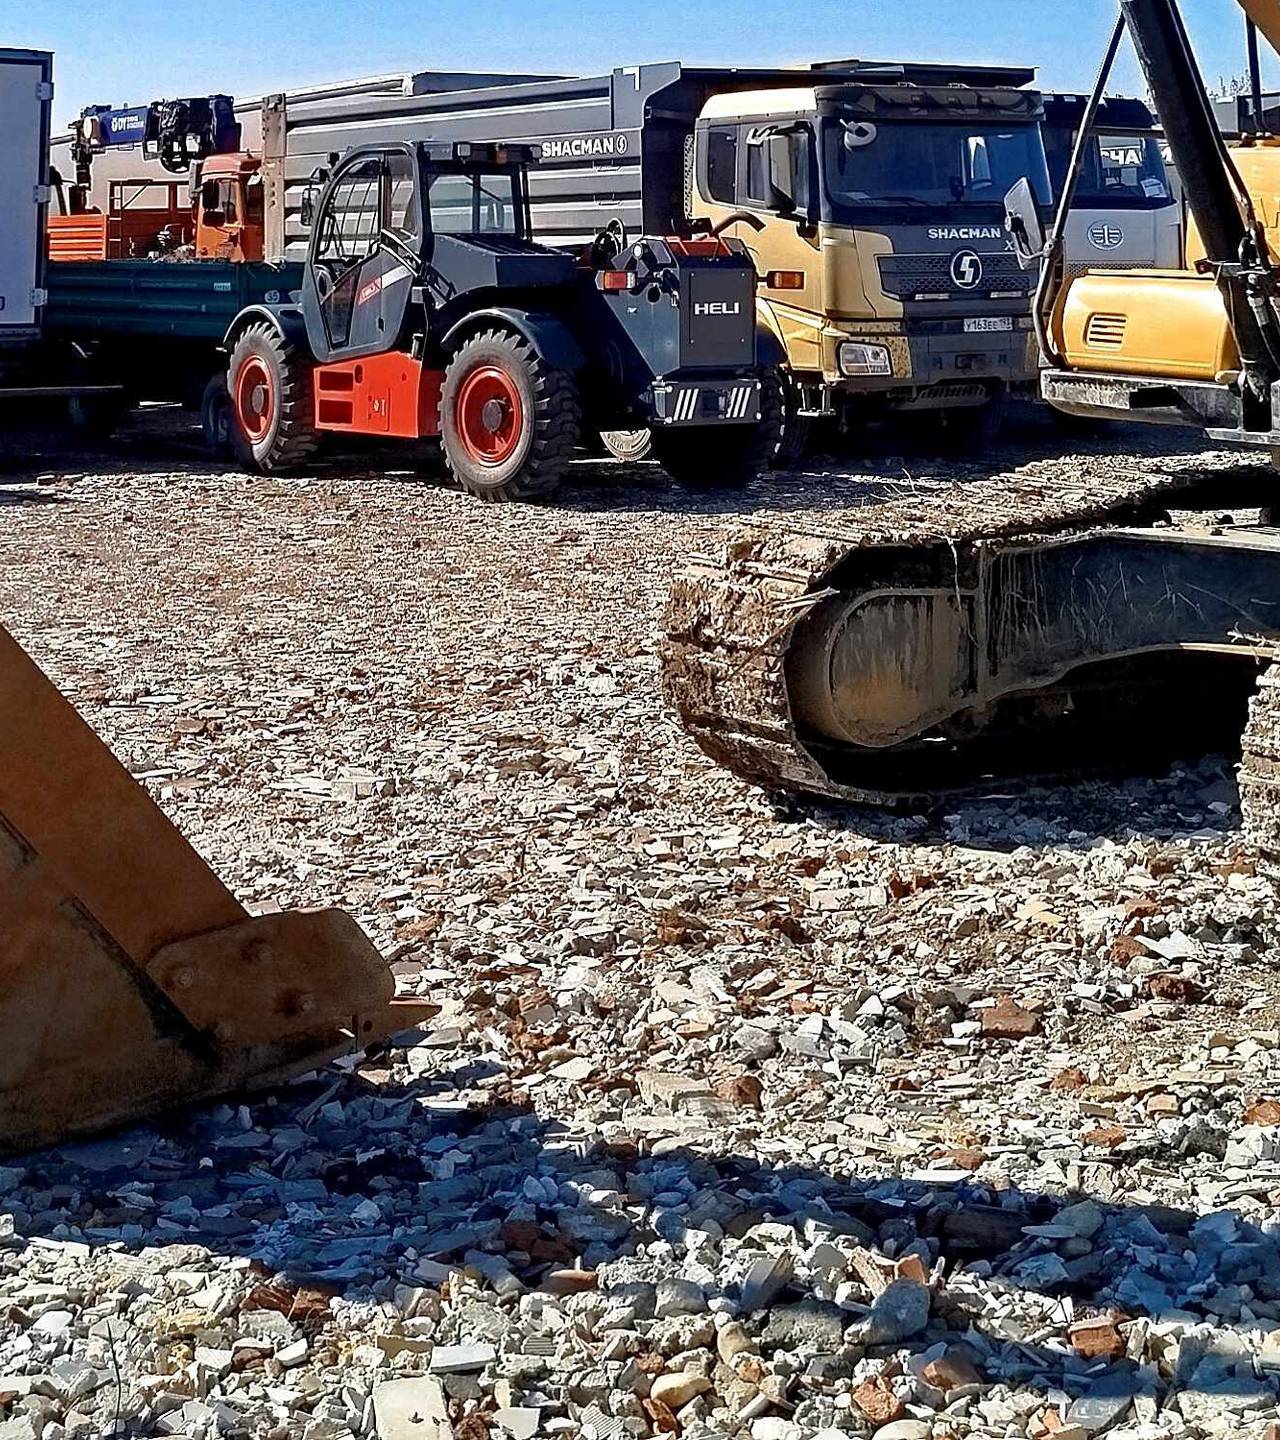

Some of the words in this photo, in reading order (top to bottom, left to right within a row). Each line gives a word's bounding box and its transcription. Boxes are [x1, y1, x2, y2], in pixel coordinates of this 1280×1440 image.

[541, 137, 614, 158] SHACMAN
[927, 227, 1002, 239] SHACMAN
[694, 302, 740, 315] HELI
